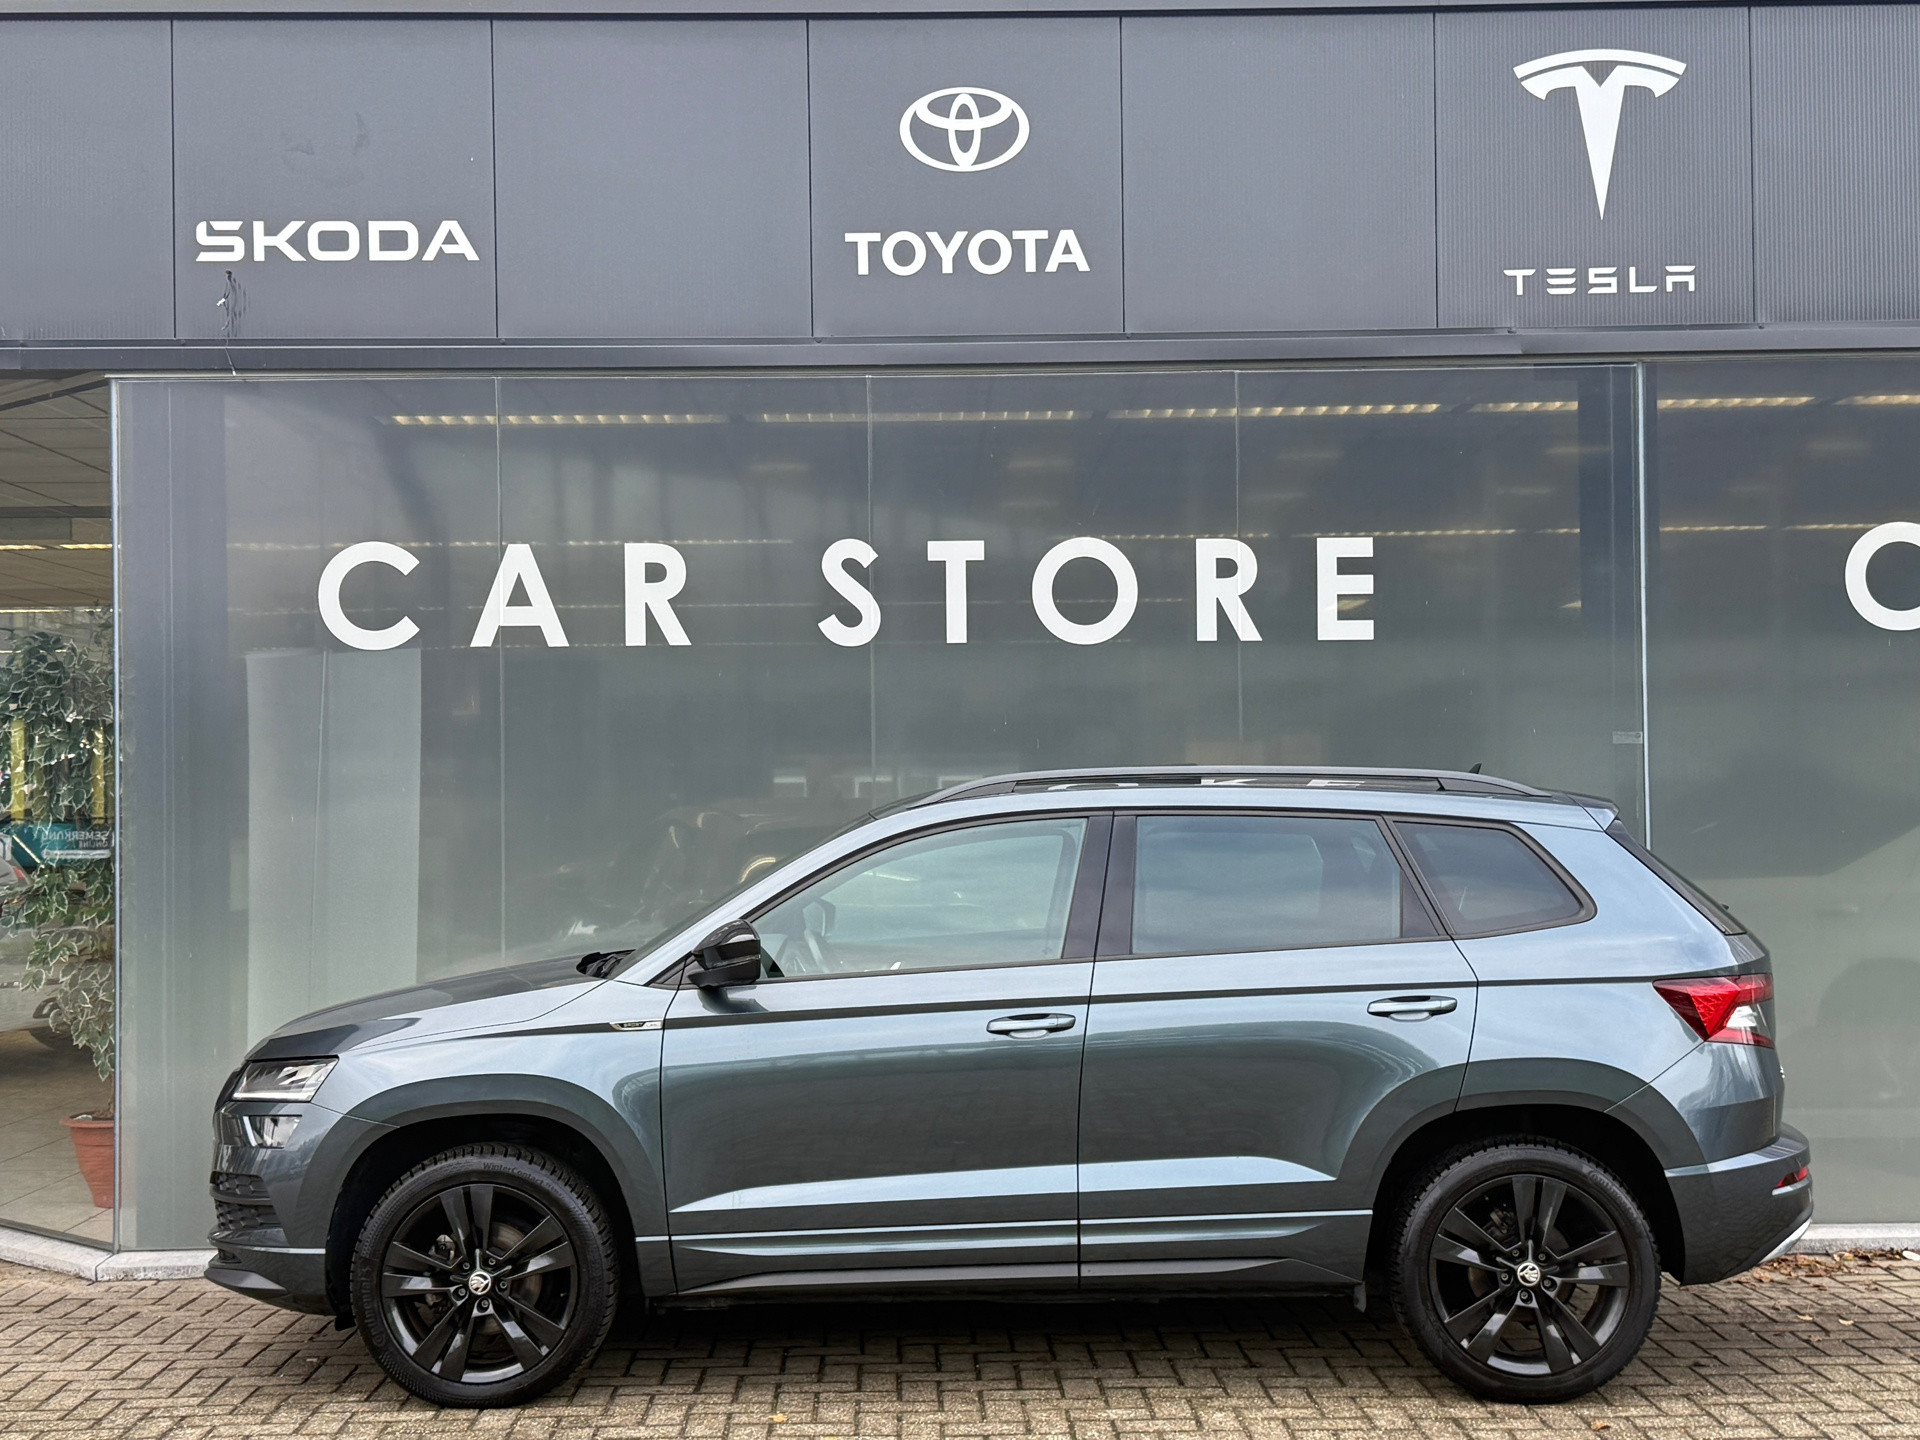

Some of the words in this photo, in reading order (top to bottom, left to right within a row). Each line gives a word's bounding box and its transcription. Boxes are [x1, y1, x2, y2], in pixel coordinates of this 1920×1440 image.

[845, 229, 1090, 276] TOYOTA
[1504, 265, 1696, 296] TESLA
[317, 541, 692, 651] CAR
[818, 536, 1375, 647] STORE
